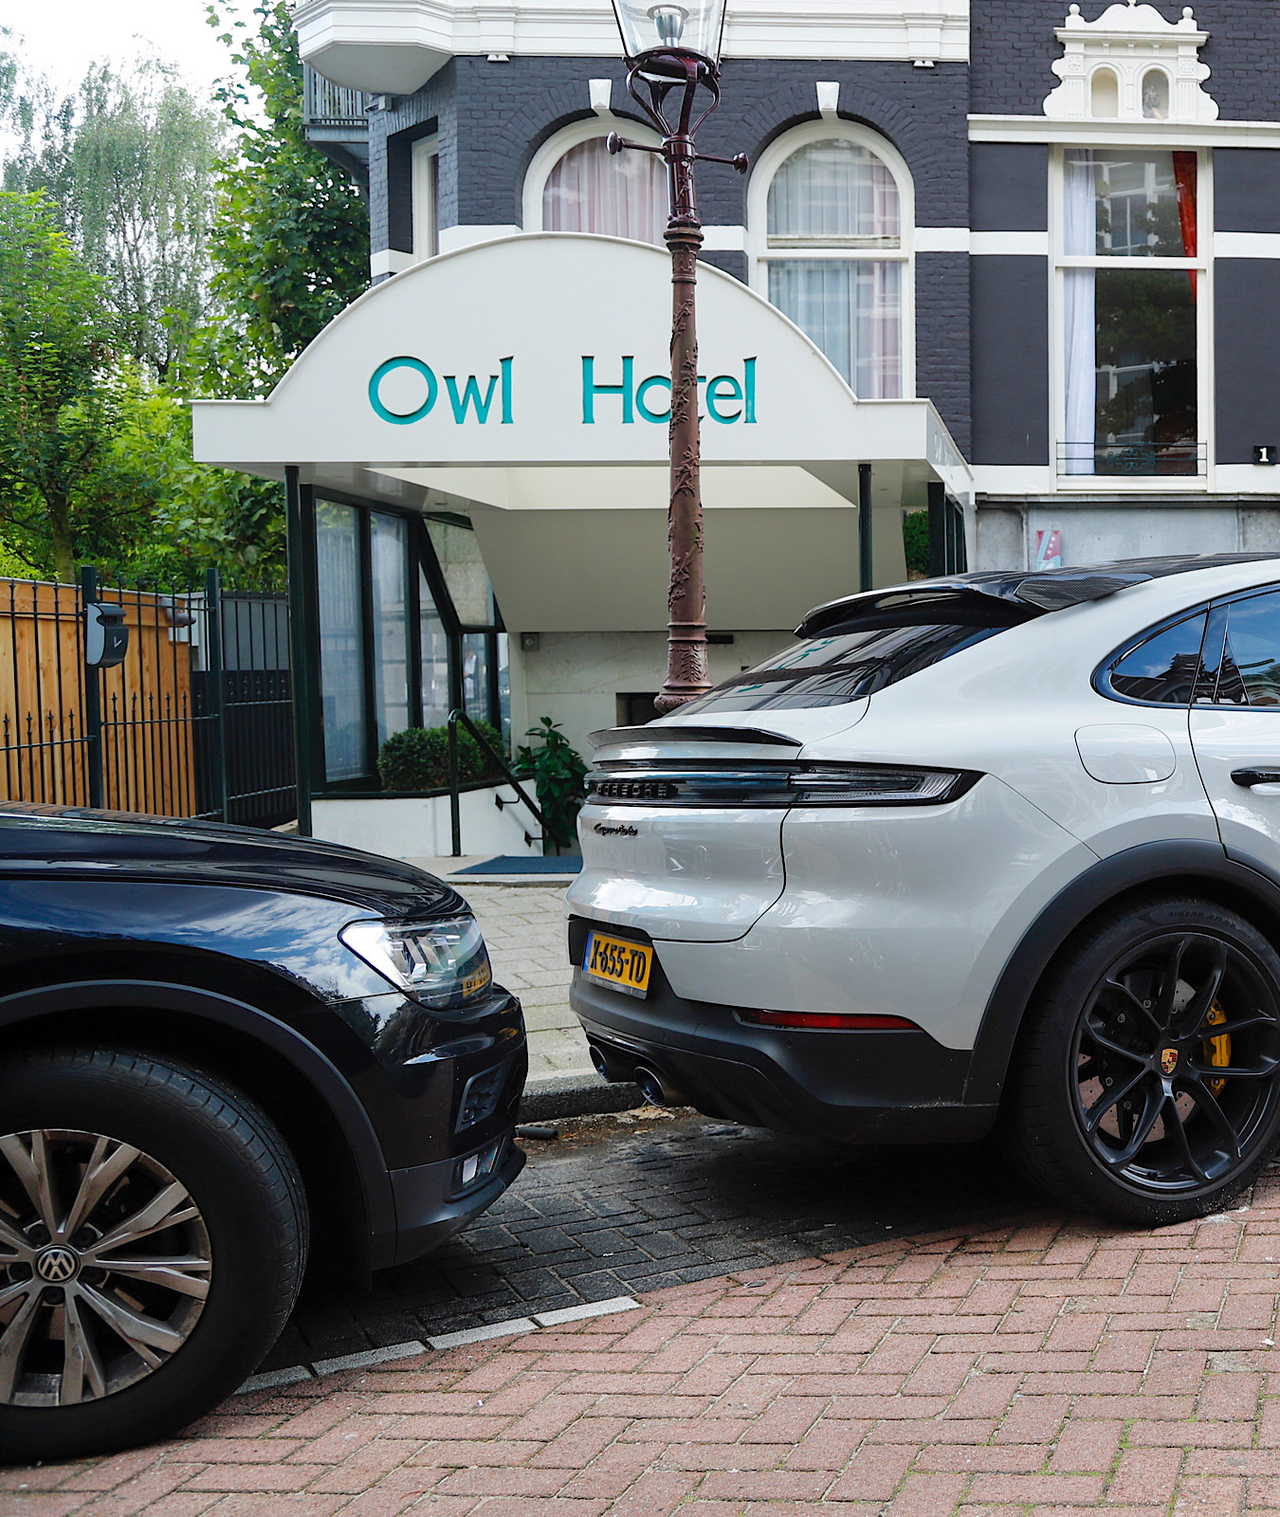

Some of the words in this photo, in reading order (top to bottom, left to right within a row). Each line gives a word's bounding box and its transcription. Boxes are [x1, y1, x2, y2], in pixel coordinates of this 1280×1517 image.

[369, 355, 514, 425] Owl
[581, 355, 758, 425] Hoel
[1259, 447, 1269, 462] 1
[590, 939, 647, 983] X-655-TD
